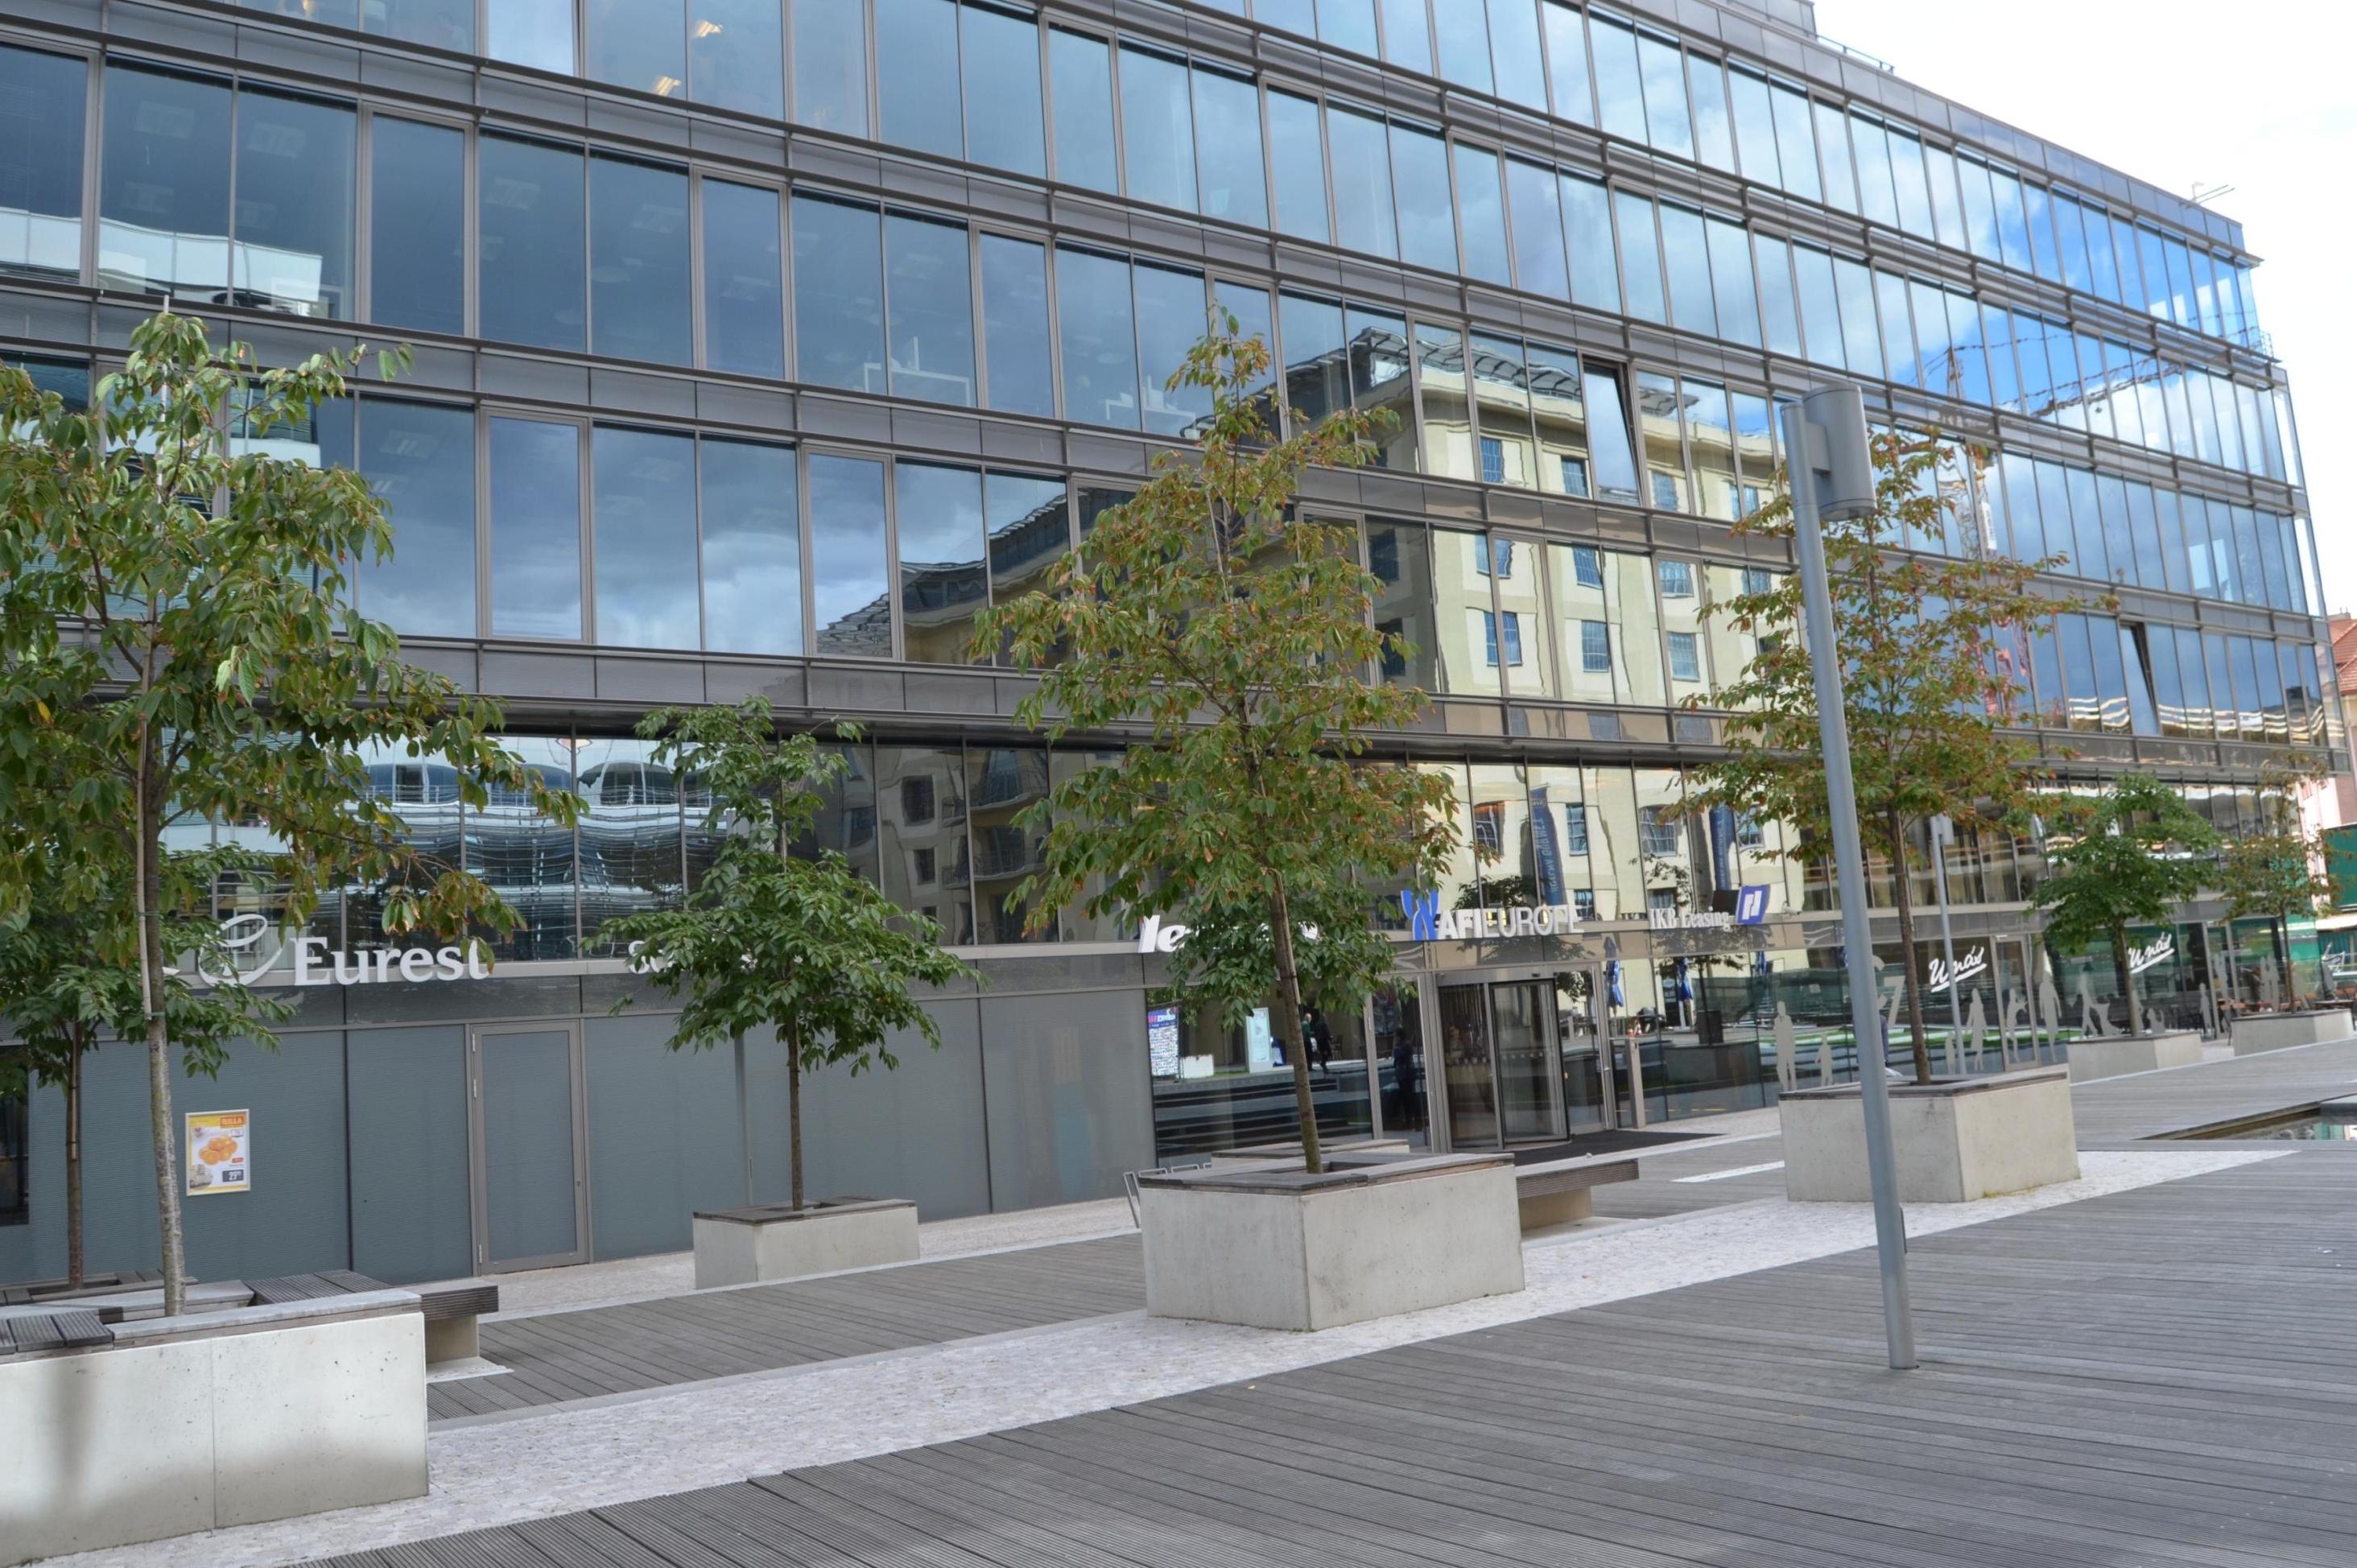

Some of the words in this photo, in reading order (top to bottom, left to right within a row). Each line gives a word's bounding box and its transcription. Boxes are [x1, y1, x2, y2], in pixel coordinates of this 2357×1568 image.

[1438, 905, 1584, 940] AFIEUROPE
[1649, 908, 1676, 929] IKB
[1680, 906, 1731, 931] Leasing
[290, 937, 489, 986] Eurest
